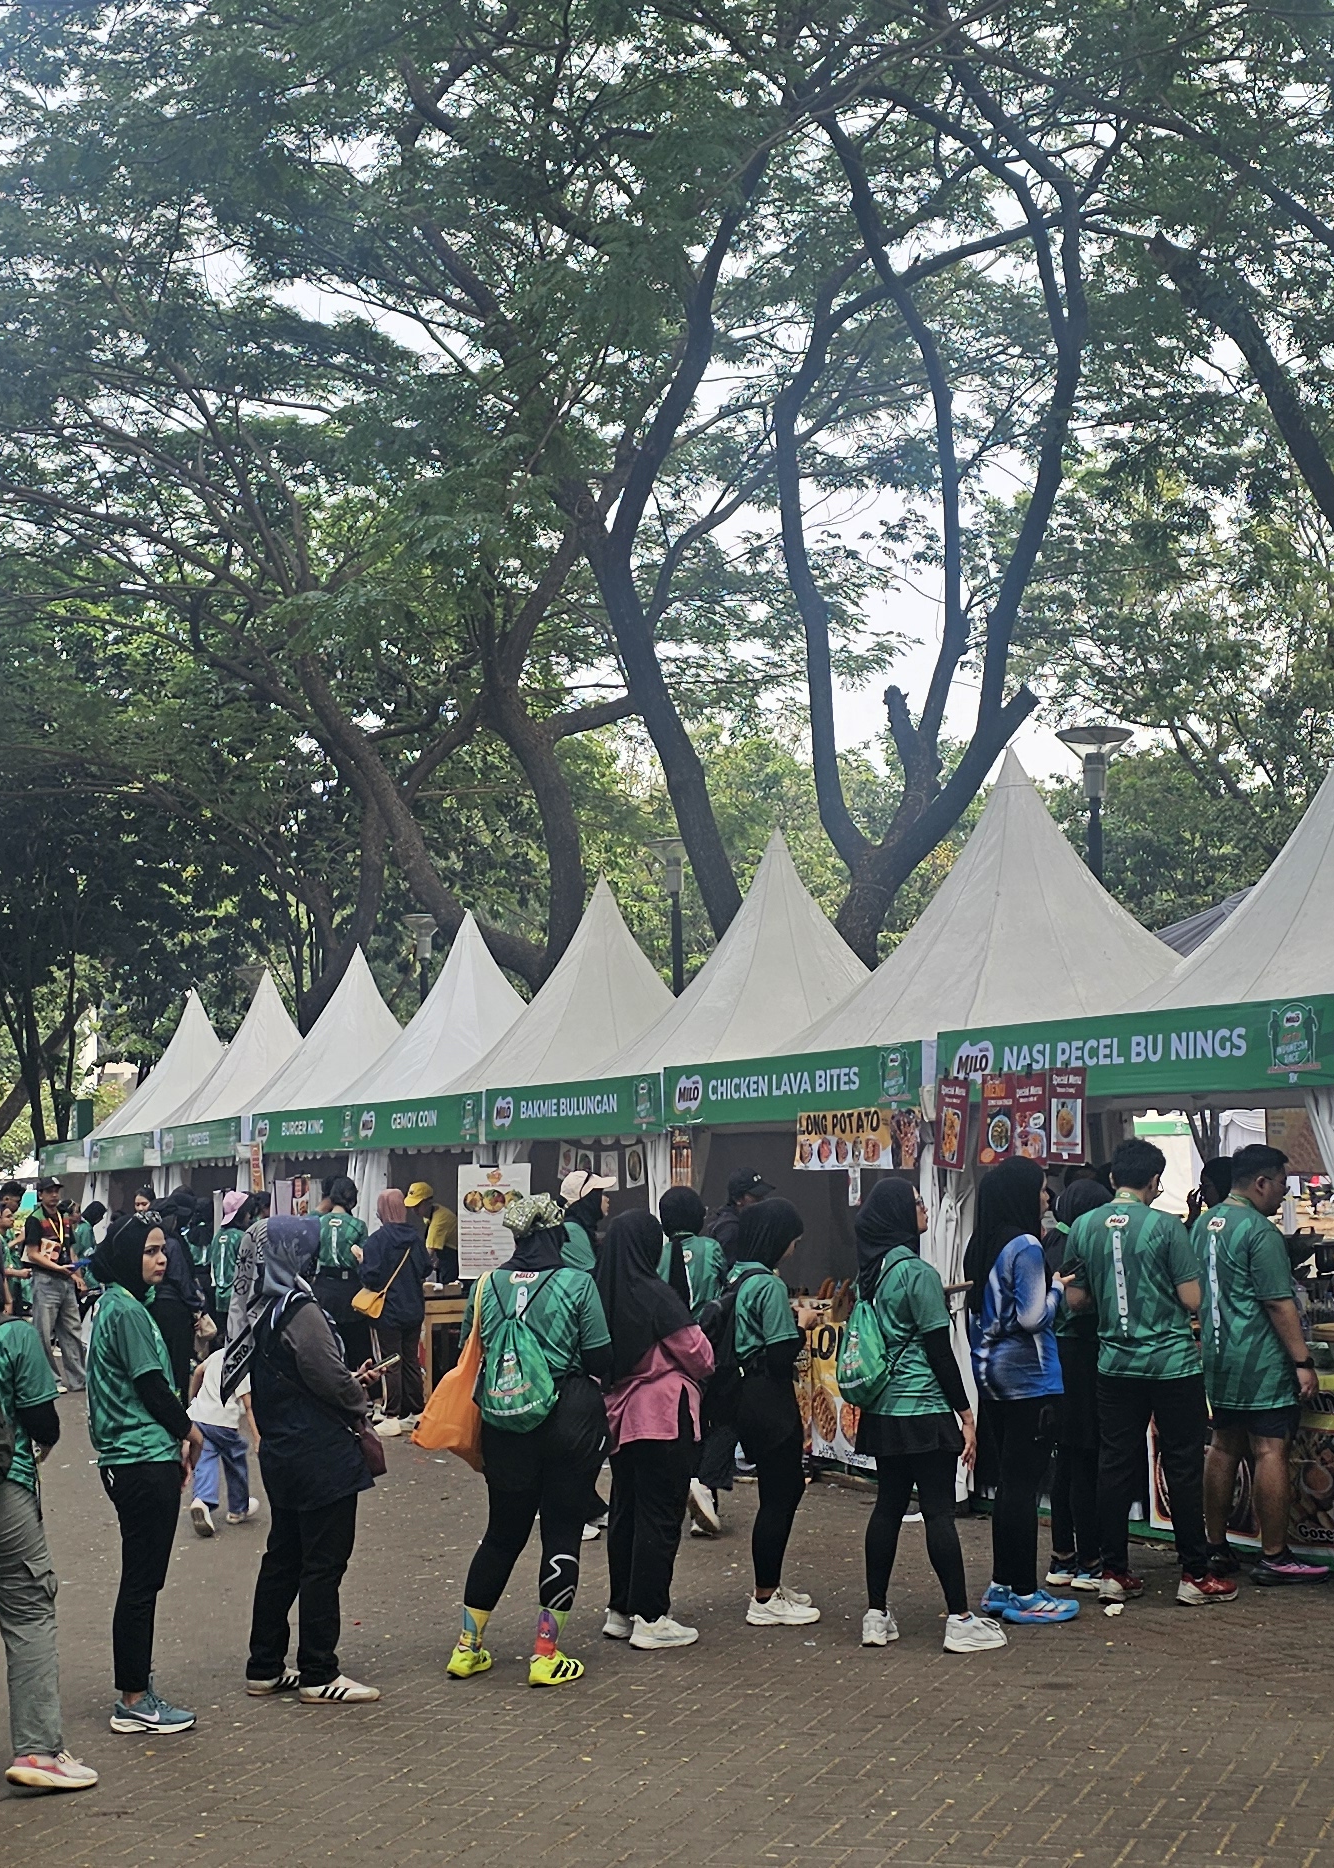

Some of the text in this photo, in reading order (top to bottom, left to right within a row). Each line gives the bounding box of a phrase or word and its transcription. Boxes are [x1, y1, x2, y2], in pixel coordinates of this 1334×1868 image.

[1002, 1027, 1247, 1071] NASI PECEL BU NINGS
[956, 1053, 991, 1075] MILO
[708, 1066, 860, 1101] CHICKEN LAVA BITES
[1052, 1074, 1082, 1085] Special Menu
[676, 1084, 700, 1104] MILO
[941, 1085, 955, 1095] Special
[1016, 1087, 1029, 1098] pecial
[496, 1104, 512, 1120] MILO
[520, 1098, 558, 1118] BAKMIE
[559, 1094, 618, 1116] BULUNGAN
[281, 1119, 324, 1136] BURGER KING
[360, 1119, 373, 1132] MILO
[391, 1110, 438, 1129] GEMOY COIN
[798, 1109, 881, 1135] LONG POTATO
[514, 1271, 536, 1279] MILO
